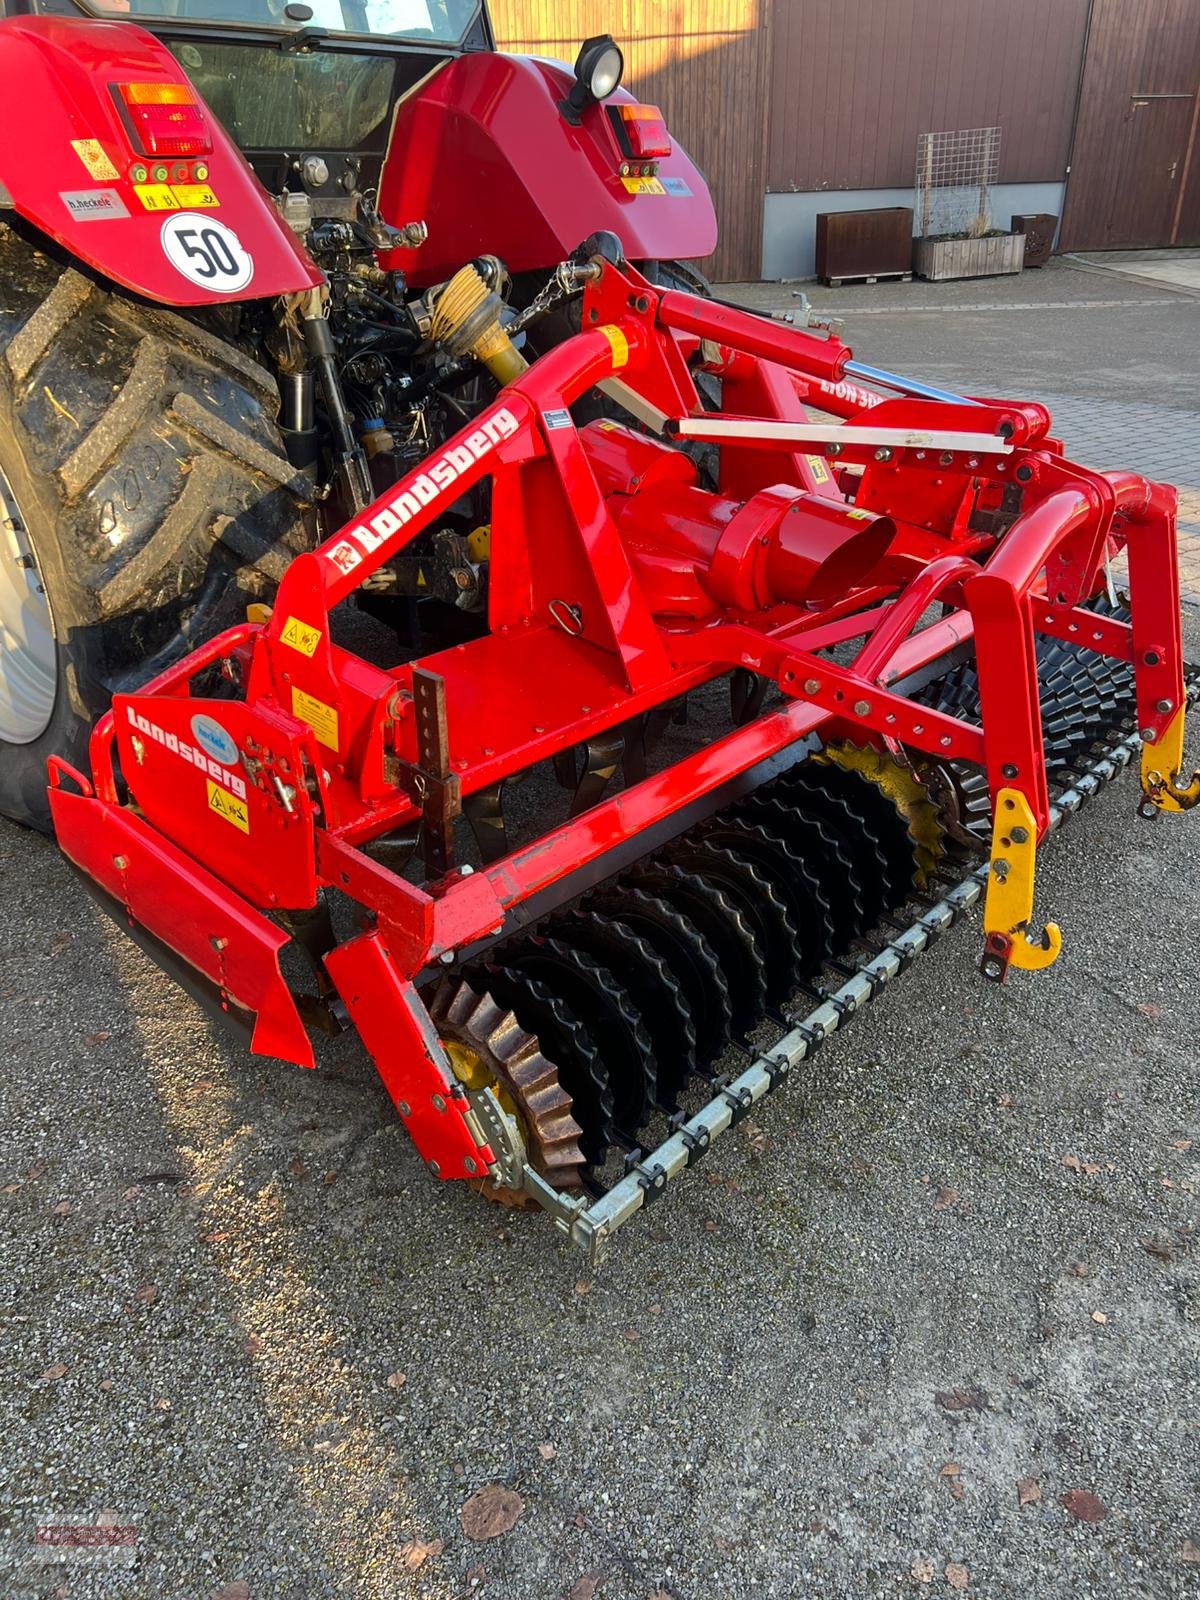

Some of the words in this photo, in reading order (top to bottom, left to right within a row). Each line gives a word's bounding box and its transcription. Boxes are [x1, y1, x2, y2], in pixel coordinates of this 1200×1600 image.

[67, 198, 112, 209] h.heckele
[174, 228, 240, 278] 50
[821, 379, 857, 404] LION
[352, 407, 520, 554] Landsberg
[126, 705, 247, 800] Landsberg
